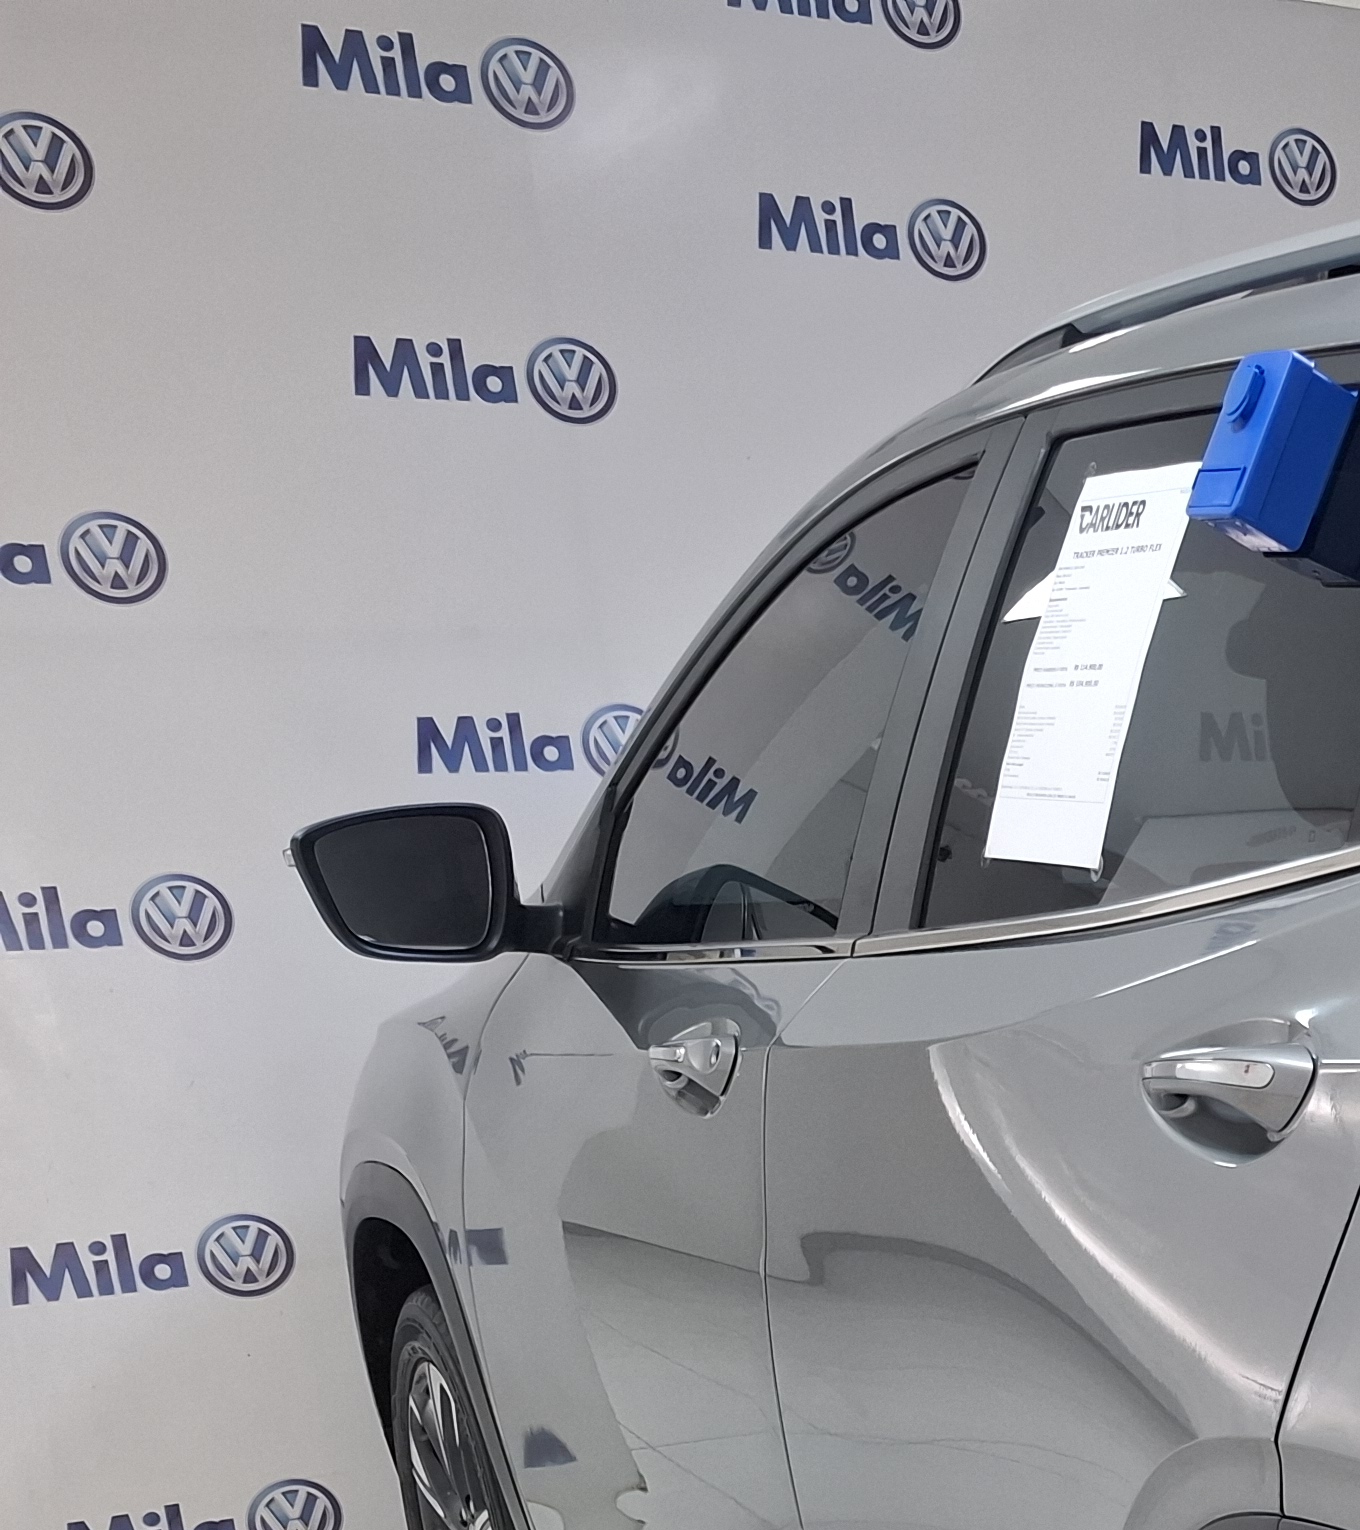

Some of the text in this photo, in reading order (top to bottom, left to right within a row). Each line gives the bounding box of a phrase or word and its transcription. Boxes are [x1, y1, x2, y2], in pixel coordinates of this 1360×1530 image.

[301, 24, 472, 104] Mila
[1139, 121, 1261, 186] Mila
[757, 192, 899, 261] Mila
[354, 335, 518, 404] Mila
[1079, 500, 1146, 534] CARLIDER
[417, 713, 574, 775] Mila
[11, 1234, 189, 1306] Mila
